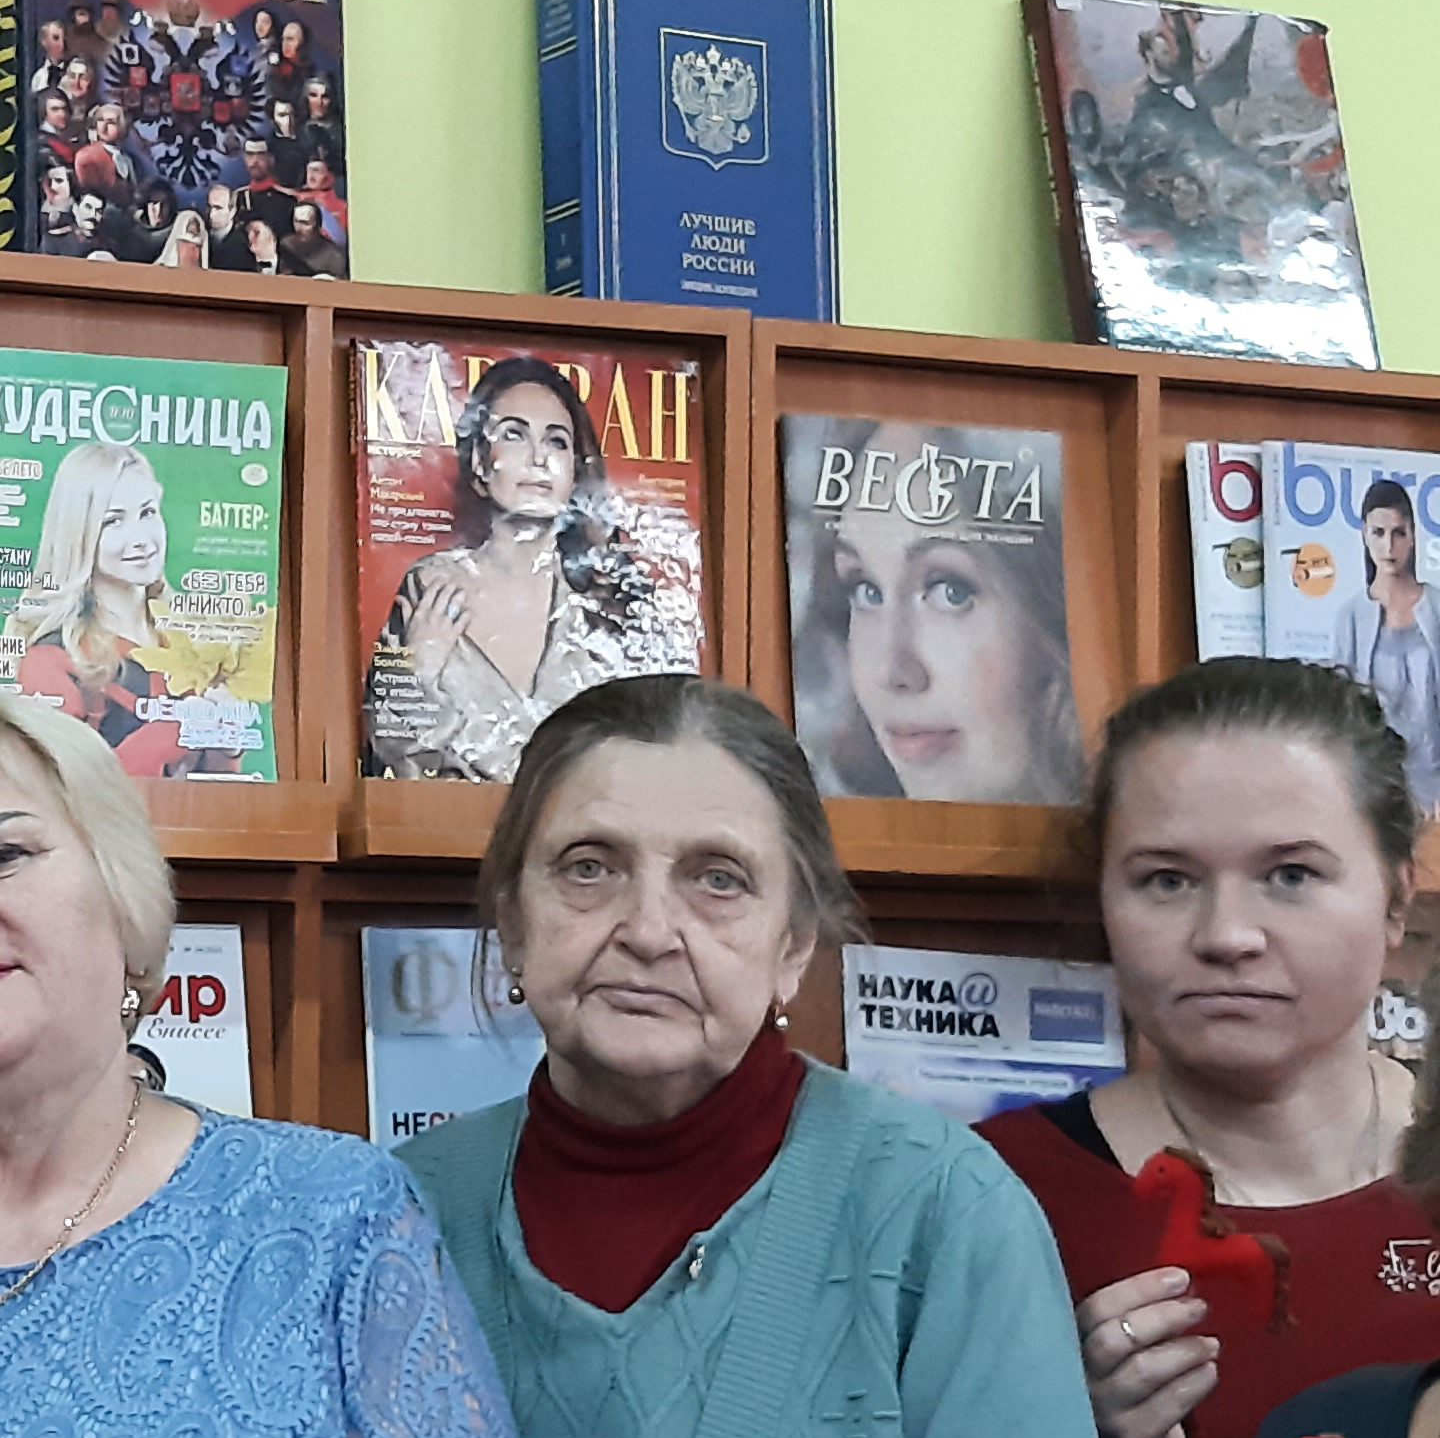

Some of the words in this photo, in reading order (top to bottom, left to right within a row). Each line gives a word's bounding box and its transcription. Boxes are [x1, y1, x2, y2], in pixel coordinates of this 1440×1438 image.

[679, 211, 757, 236] ЛУЧШИЕ
[690, 233, 746, 255] ЛЮДИ
[682, 252, 756, 277] РОССИИ
[364, 347, 693, 463] КААН
[200, 502, 269, 530] БАТТЕР:
[226, 573, 265, 592] ТЕБЯ
[857, 973, 956, 1005] НАУКА
[859, 1004, 1000, 1038] ТЕХНИКА
